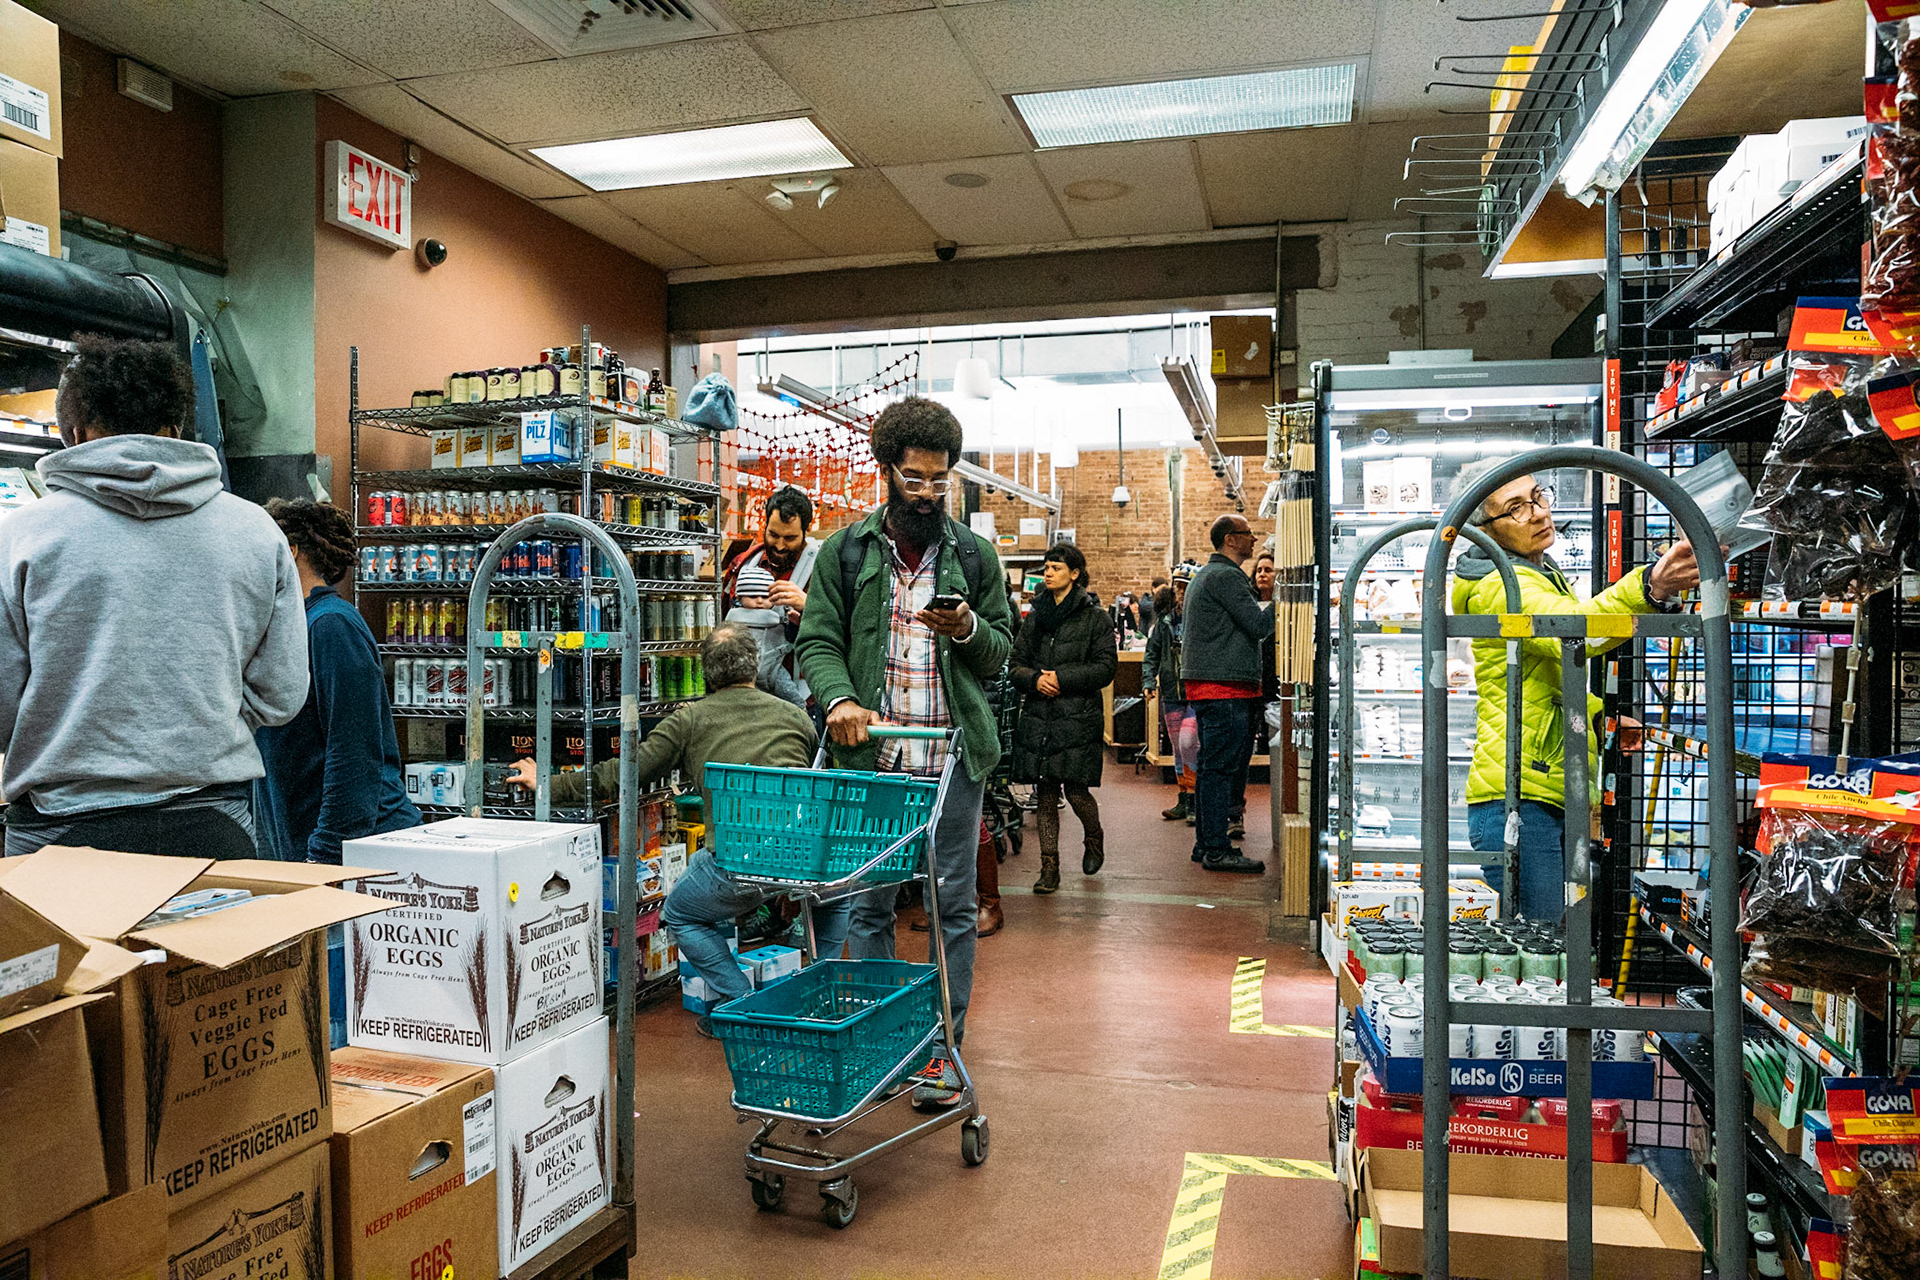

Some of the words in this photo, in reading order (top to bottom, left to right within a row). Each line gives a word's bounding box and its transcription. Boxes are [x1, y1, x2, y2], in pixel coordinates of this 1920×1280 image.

[349, 152, 405, 235] EXIT
[1609, 399, 1616, 416] ME
[526, 425, 545, 439] PILZ
[555, 427, 570, 449] PILZ
[1609, 433, 1617, 500] SENAL
[1611, 550, 1618, 567] ME
[511, 735, 536, 747] LION
[566, 737, 584, 749] LIO
[1810, 773, 1870, 794] GOYA
[1841, 794, 1869, 805] Ancho
[428, 893, 462, 911] YOKE
[1347, 903, 1390, 920] Sweet
[1454, 904, 1492, 920] Sweet
[385, 910, 443, 921] CERTIFIED
[530, 918, 564, 942] NATURE'S
[564, 912, 582, 930] YOKE
[370, 922, 459, 948] ORGANIC
[538, 935, 571, 953] CERTIFIED
[387, 947, 443, 968] EGGS
[531, 940, 580, 972] ORGANIC
[186, 965, 252, 1000] NATURE'S
[413, 972, 428, 980] Cage
[542, 961, 571, 984] EGGS
[195, 998, 238, 1022] Cage
[246, 983, 283, 1006] Free
[190, 1015, 251, 1047] Veggie
[259, 1000, 287, 1024] Fed
[384, 1015, 455, 1029] www.NaturesYoke.com
[514, 1018, 537, 1044] KEEP
[538, 993, 595, 1032] REFRIGERATED
[361, 1018, 390, 1037] KEEP
[394, 1022, 483, 1048] REFRIGERATED
[203, 1030, 276, 1080] EGGS
[174, 1085, 207, 1104] Always
[209, 1076, 231, 1092] from
[234, 1066, 256, 1080] Cage
[259, 1058, 278, 1070] Free
[281, 1048, 301, 1060] Hens
[1451, 1067, 1496, 1086] KelSo
[1529, 1073, 1563, 1084] BEER
[1466, 1095, 1511, 1107] REKORDERLIG
[1867, 1095, 1913, 1112] GOYA
[199, 1112, 287, 1155] www.NaturesYoke.com
[534, 1118, 569, 1148] NATURE'S
[569, 1109, 588, 1129] YOKE
[1448, 1122, 1529, 1140] REKORDERLIG
[210, 1108, 318, 1177] REFRIGERATED
[543, 1132, 577, 1157] CERTIFIED
[535, 1135, 586, 1178] ORGANIC
[1860, 1150, 1916, 1168] GOYA
[546, 1158, 577, 1187] EGGS
[366, 1212, 393, 1239] KEEP
[396, 1172, 465, 1222] REFRIGERATED
[519, 1224, 542, 1253] KEEP
[544, 1184, 603, 1236] REFRIGERATED
[182, 1233, 252, 1280] NATURE'S
[252, 1213, 290, 1248] YOKE
[245, 1247, 284, 1277] Free
